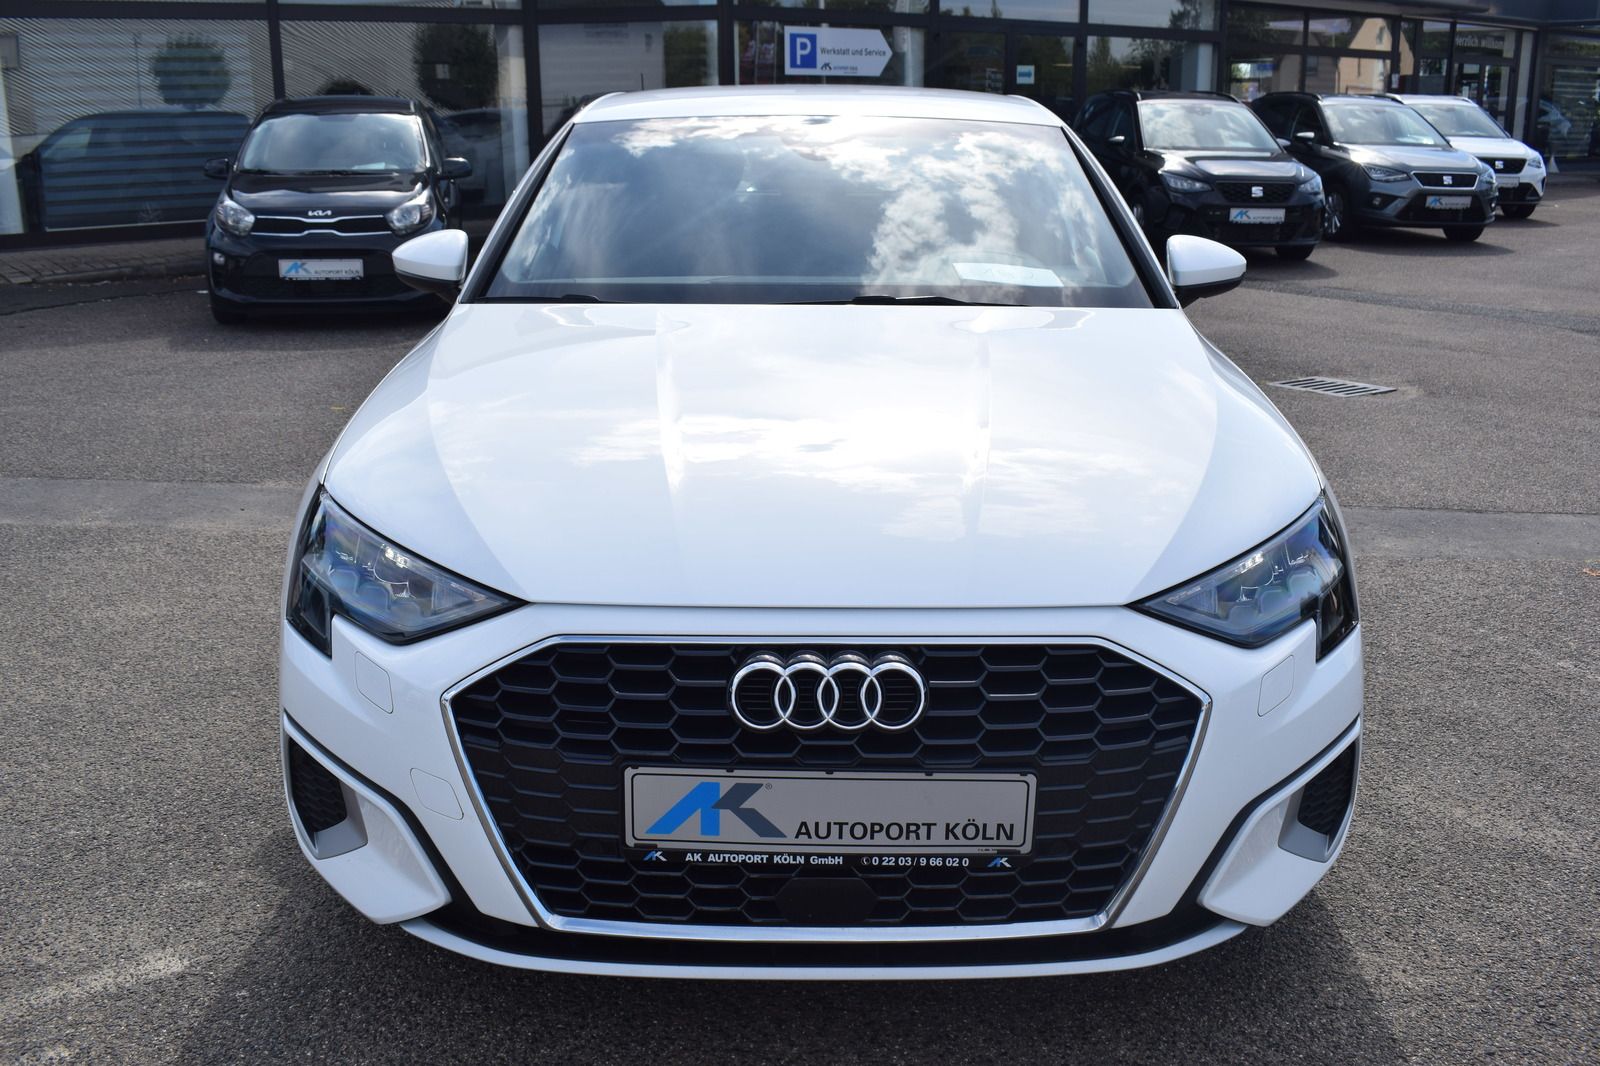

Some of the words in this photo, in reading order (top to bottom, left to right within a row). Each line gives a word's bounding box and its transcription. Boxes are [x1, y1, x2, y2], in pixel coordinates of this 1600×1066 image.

[795, 37, 812, 66] P
[820, 47, 850, 56] Werkstatt
[851, 48, 863, 56] und
[864, 48, 886, 57] Service
[644, 781, 788, 839] AK
[794, 821, 937, 841] AUTOPORT
[944, 818, 1015, 841] KÖLN
[685, 852, 702, 862] AK
[707, 853, 768, 864] AUTOPORT
[773, 853, 805, 864] KÖLN
[810, 855, 843, 865] GmbH
